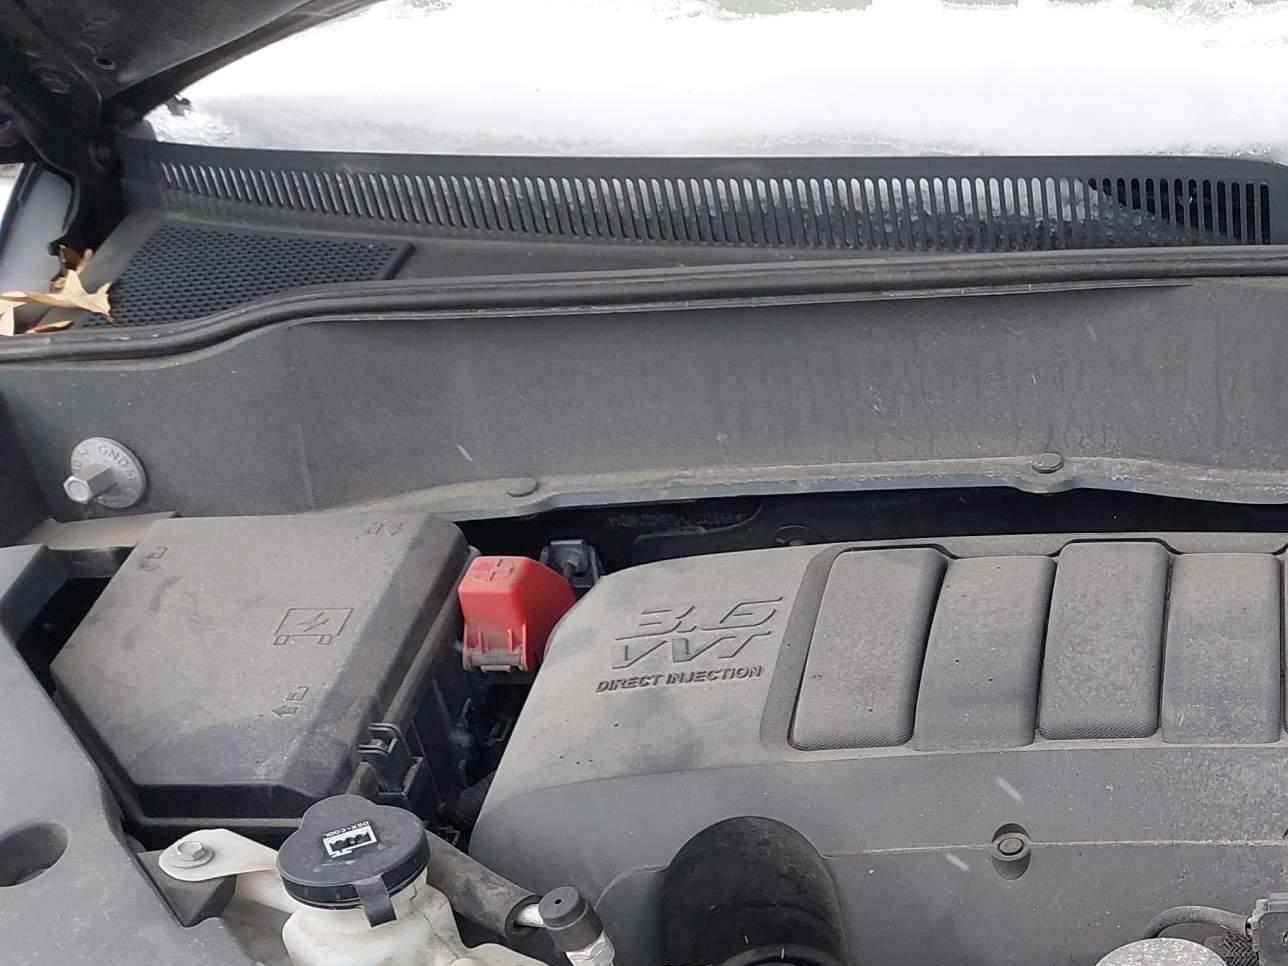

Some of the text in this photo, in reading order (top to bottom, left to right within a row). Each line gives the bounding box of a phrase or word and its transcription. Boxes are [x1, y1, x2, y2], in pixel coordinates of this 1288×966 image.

[613, 596, 785, 641] 3.6
[611, 630, 772, 670] VVT
[594, 664, 764, 693] DIRECT INJECTION
